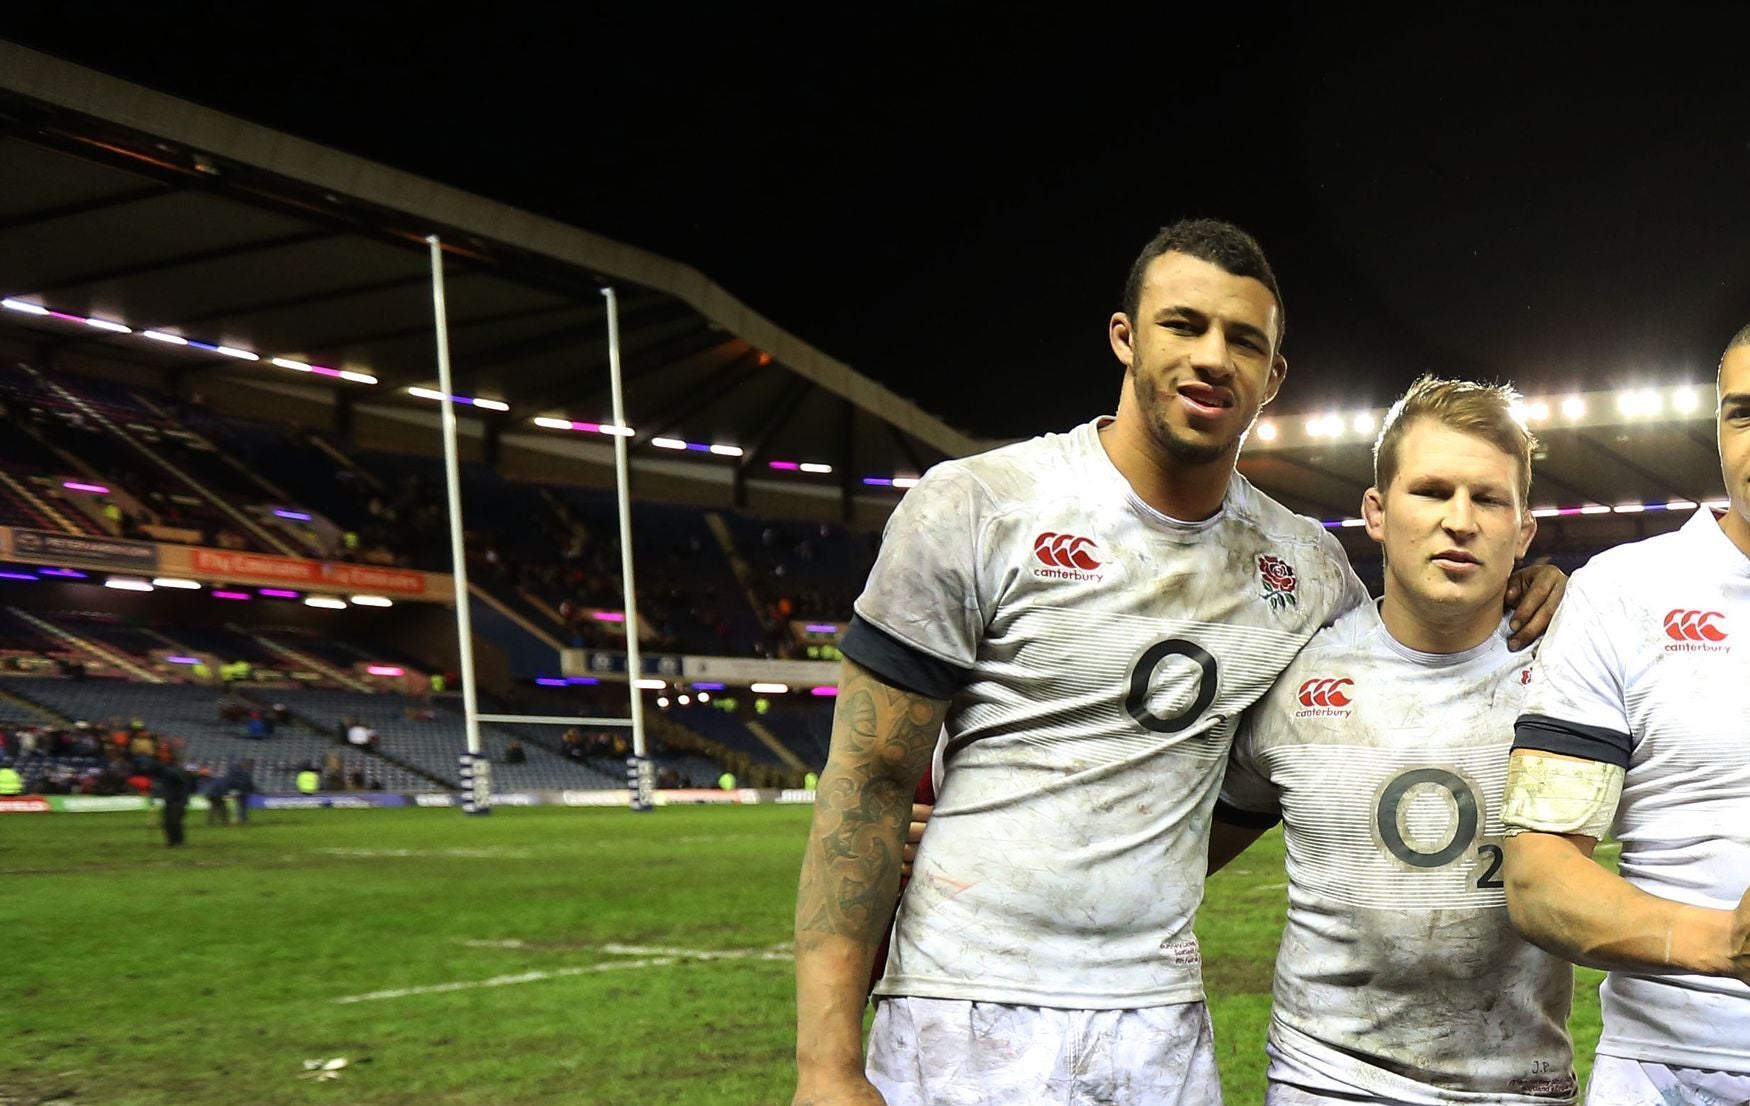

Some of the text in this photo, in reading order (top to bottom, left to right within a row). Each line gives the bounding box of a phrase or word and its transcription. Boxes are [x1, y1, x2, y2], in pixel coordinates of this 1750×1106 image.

[1033, 569, 1104, 583] canterbury
[1664, 643, 1732, 654] canterbury
[1295, 707, 1352, 719] canterbury
[1377, 768, 1504, 888] O2
